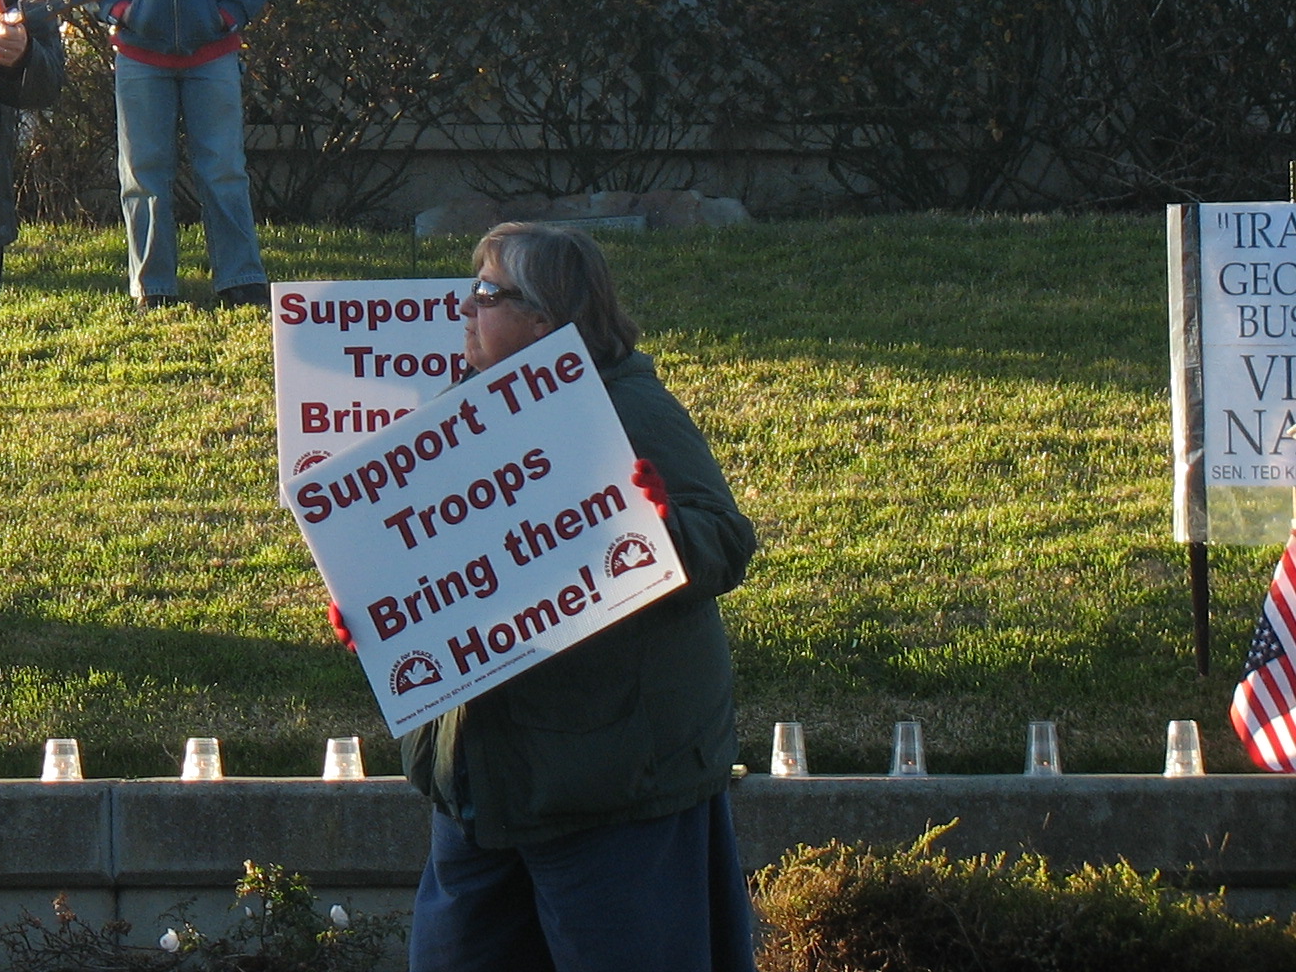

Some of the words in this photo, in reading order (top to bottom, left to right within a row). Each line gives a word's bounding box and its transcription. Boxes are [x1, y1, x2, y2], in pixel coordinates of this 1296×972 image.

[280, 290, 460, 331] Support
[344, 346, 465, 384] Troop
[297, 399, 486, 523] Support
[487, 352, 585, 415] The
[301, 402, 415, 433] Brin
[384, 448, 552, 550] Troops
[1212, 465, 1246, 479] SEN.
[1251, 465, 1281, 479] TED
[367, 554, 499, 641] Bring
[505, 484, 627, 567] them
[448, 565, 603, 675] Home!
